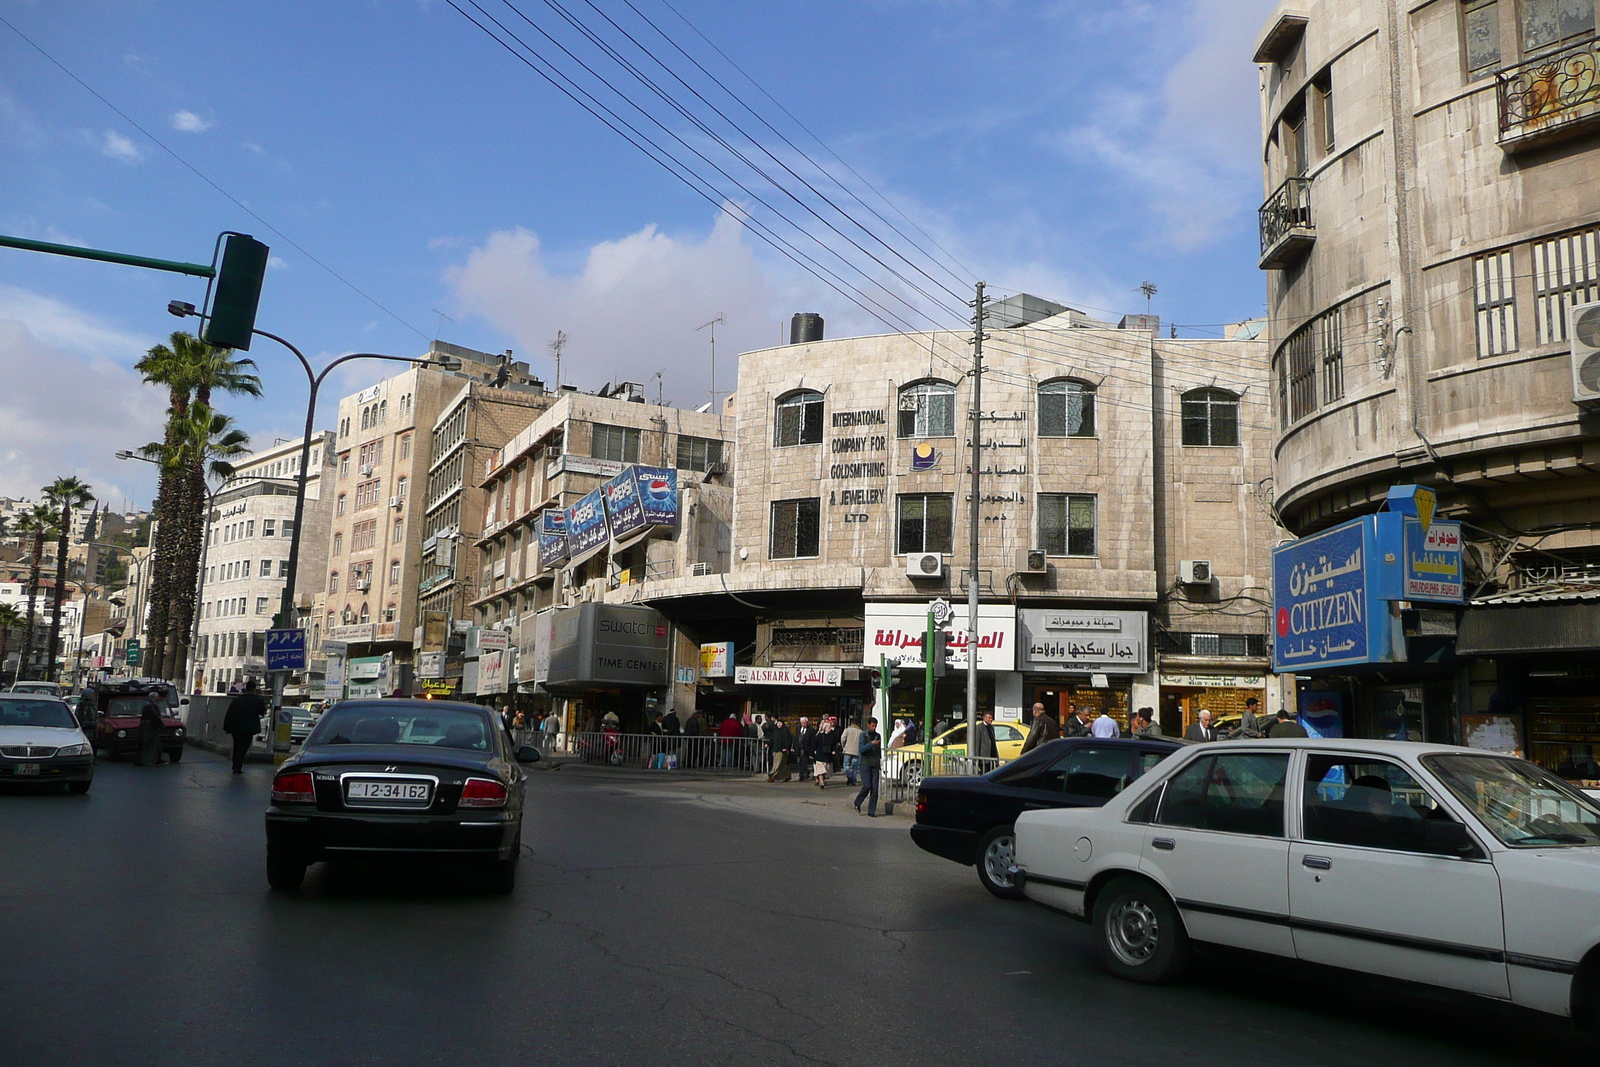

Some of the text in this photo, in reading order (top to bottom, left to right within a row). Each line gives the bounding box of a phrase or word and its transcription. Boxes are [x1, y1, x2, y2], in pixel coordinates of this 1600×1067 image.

[832, 435, 886, 454] COMPANY FOR
[830, 462, 885, 479] GOLDSMITHING
[614, 478, 633, 503] PEPSI
[830, 489, 885, 506] & JEWELLERY
[575, 503, 594, 525] PEPSI
[844, 514, 869, 523] LTD
[1290, 547, 1361, 597] سيتيزن
[1412, 551, 1459, 580] فيلادلفيا
[1409, 580, 1459, 596] PHILADELPHIA JEWELRY
[1290, 589, 1362, 635] CITIZEN
[600, 620, 656, 635] swatch
[1051, 617, 1084, 627] مجوهرات
[1093, 617, 1114, 628] صياغة
[1030, 641, 1134, 659] جمال سكجها واولاده
[1284, 634, 1355, 659] حسان خلف
[598, 657, 664, 671] TIME CENTER
[750, 670, 790, 682] AL-SHARK
[793, 668, 825, 685] الشرق
